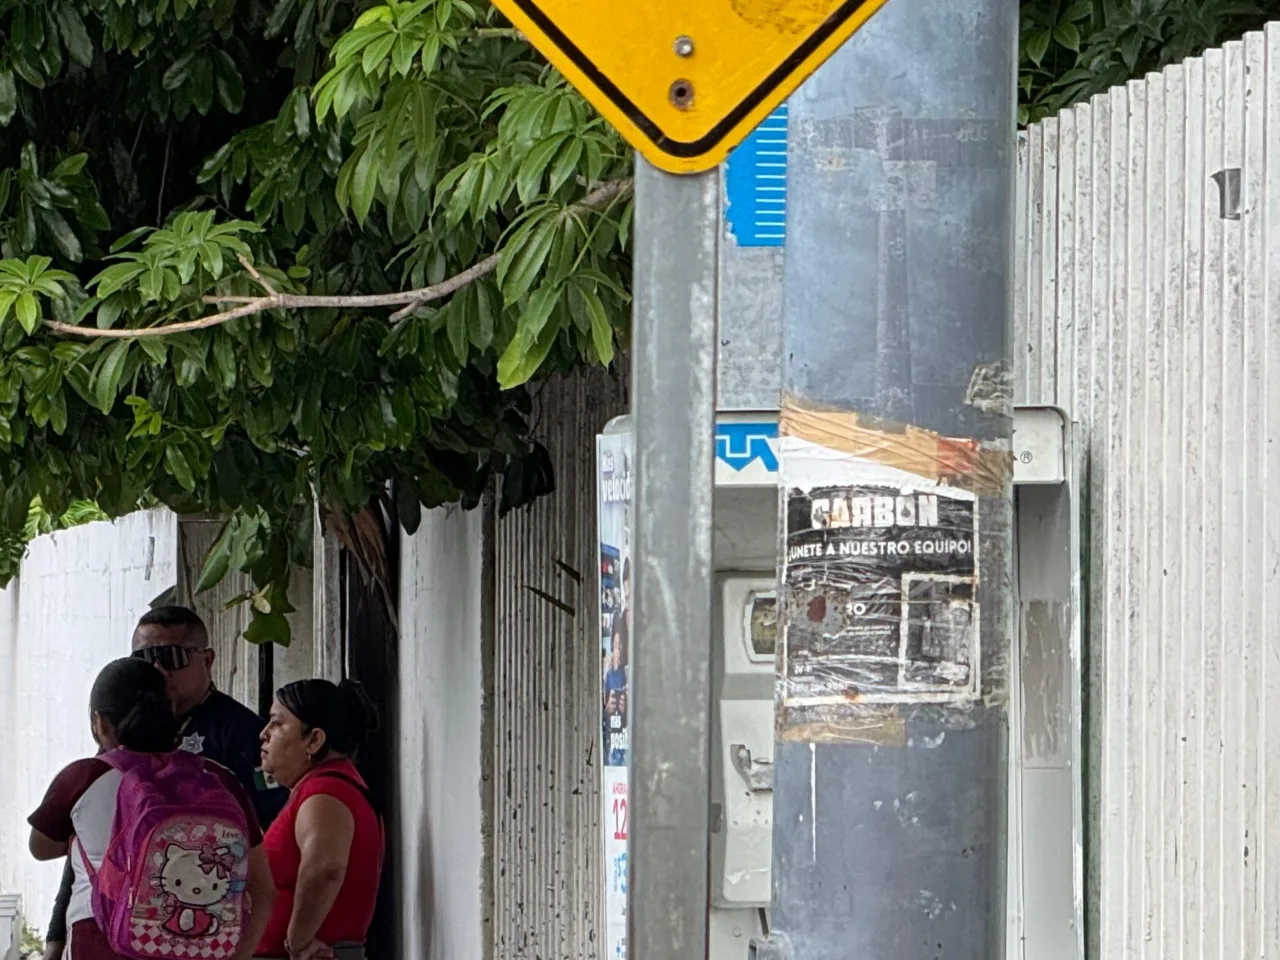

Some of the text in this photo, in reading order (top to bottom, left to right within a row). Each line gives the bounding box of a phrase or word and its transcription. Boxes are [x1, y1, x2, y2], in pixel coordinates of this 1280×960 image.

[602, 472, 631, 502] velocid
[826, 543, 835, 555] A
[840, 541, 910, 555] NUESTRO
[914, 540, 971, 554] EQUIPO!
